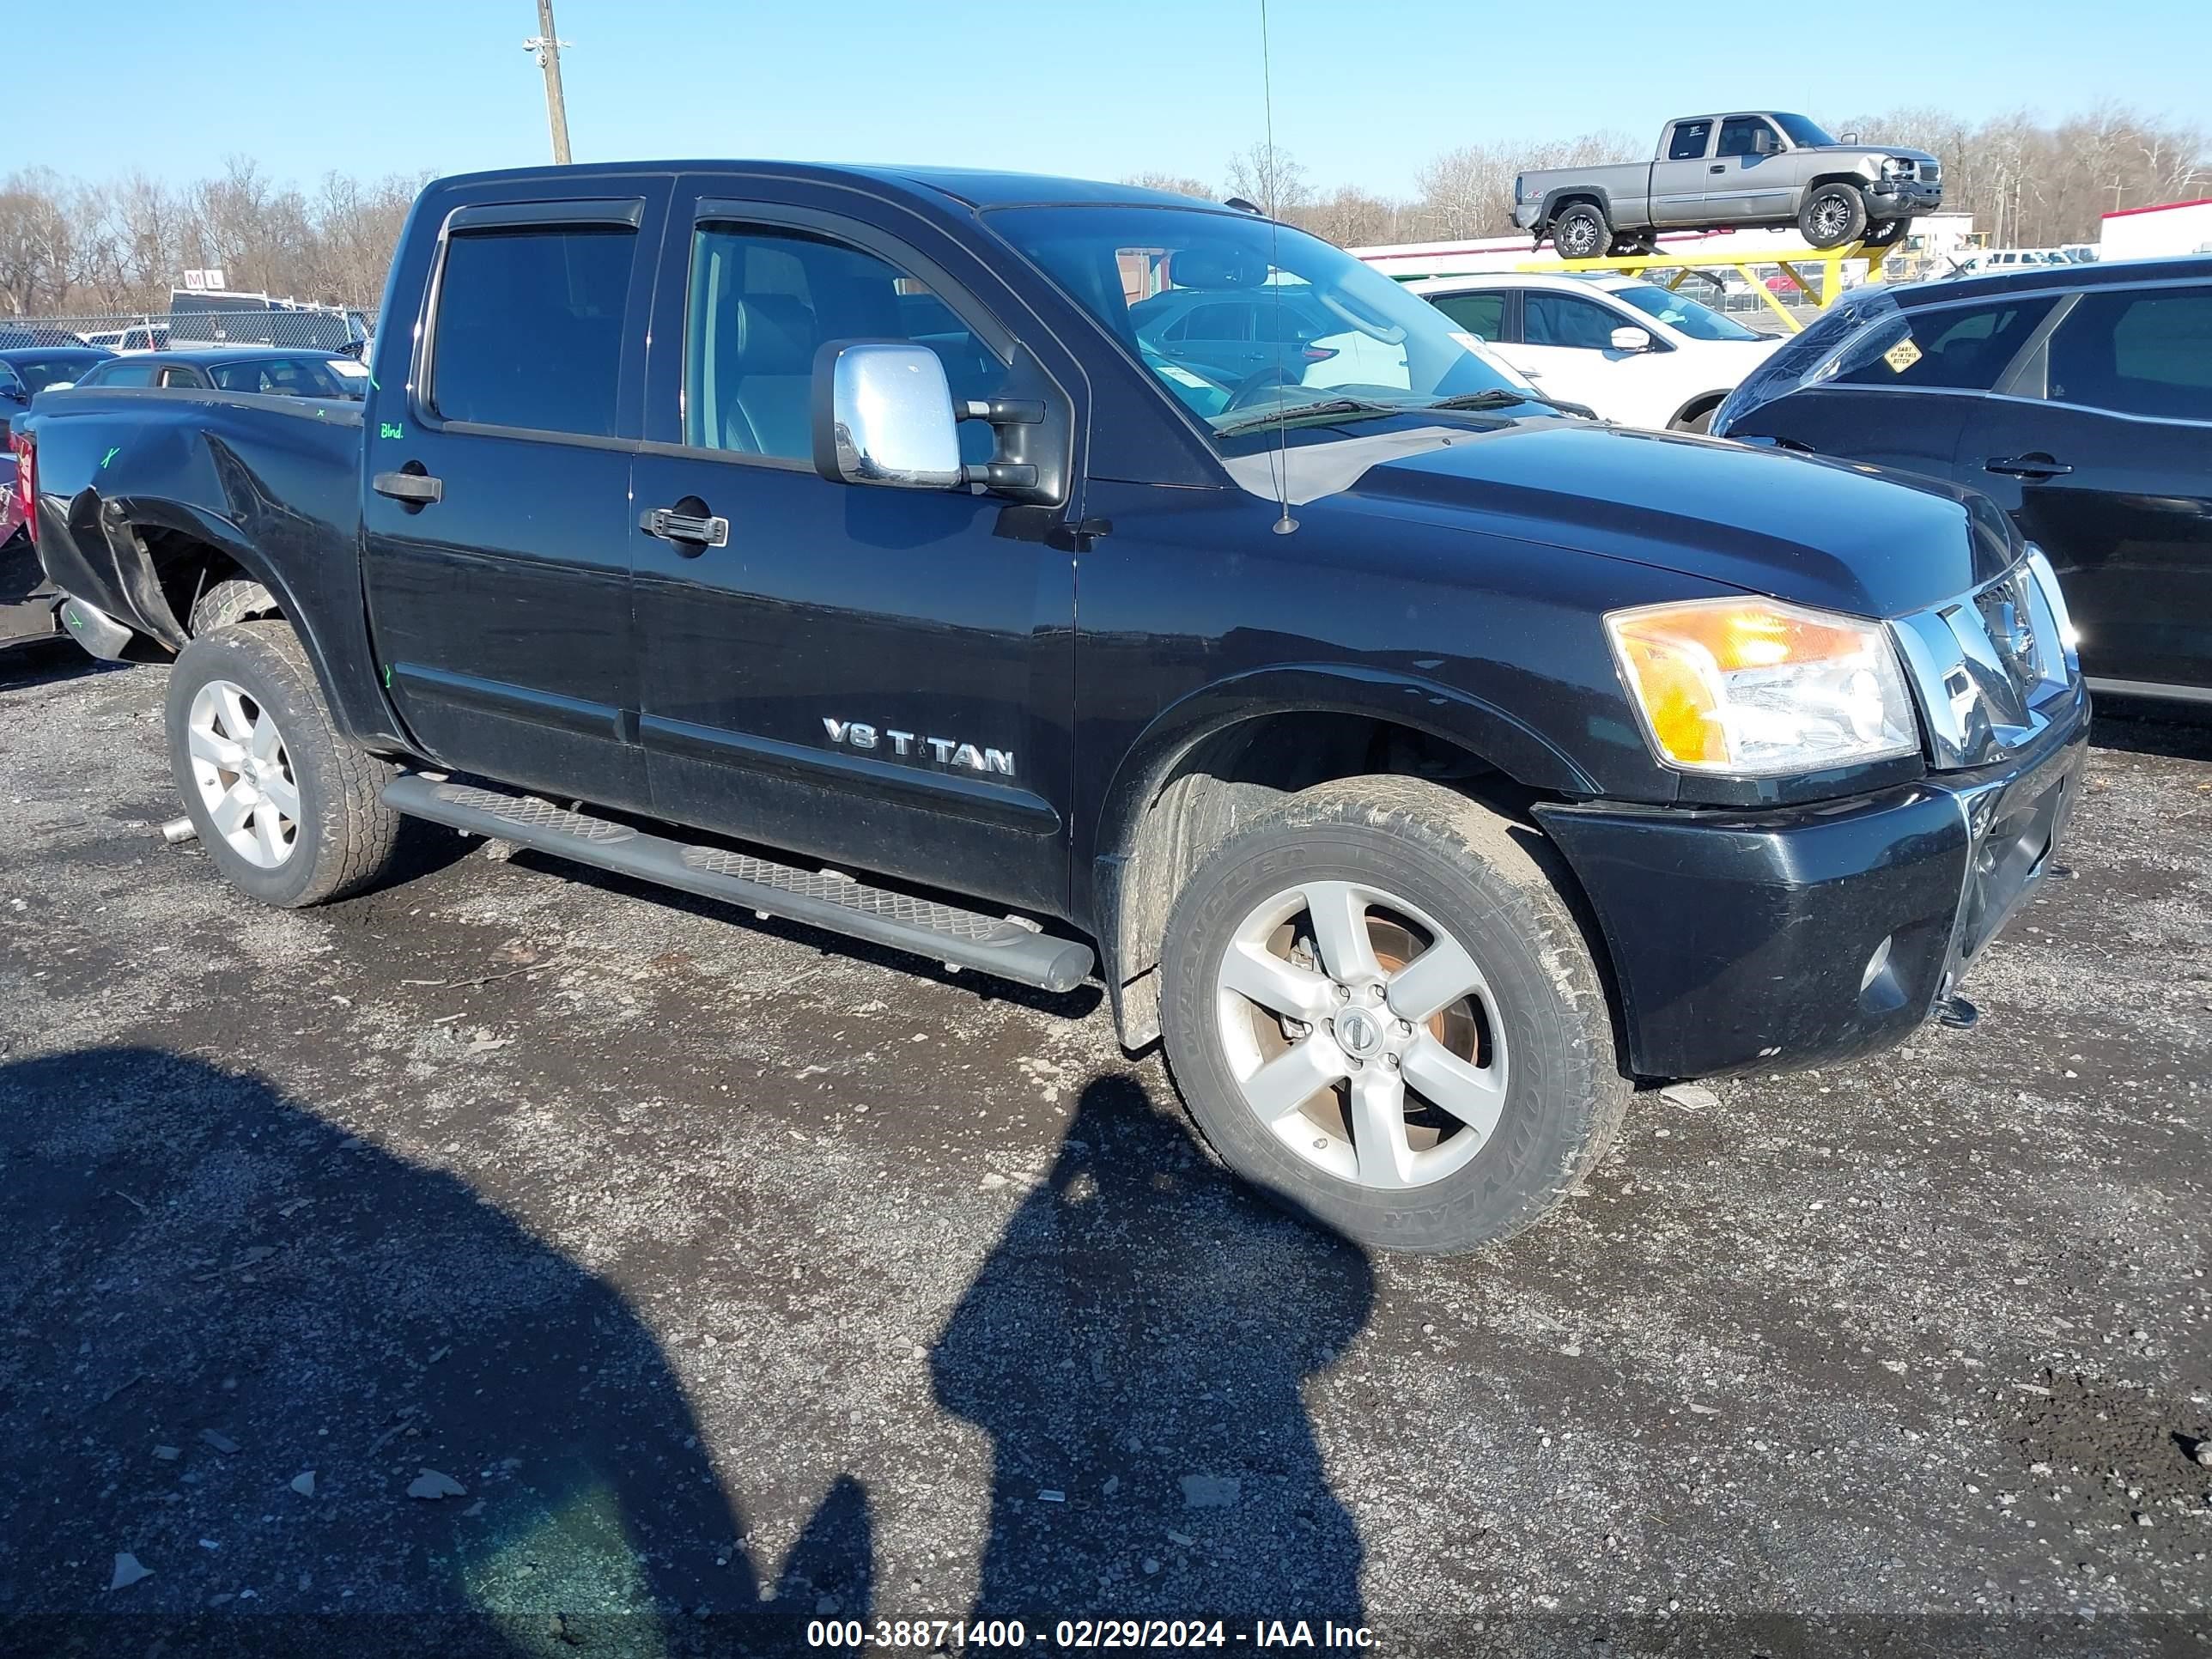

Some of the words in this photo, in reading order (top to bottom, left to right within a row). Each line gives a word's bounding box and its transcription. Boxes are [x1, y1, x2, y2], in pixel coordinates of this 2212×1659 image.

[188, 274, 202, 285] M
[211, 274, 221, 284] L
[822, 717, 879, 749] V8
[1180, 848, 1307, 1056] WRANGLER
[1383, 1008, 1543, 1230] GOODYEAR
